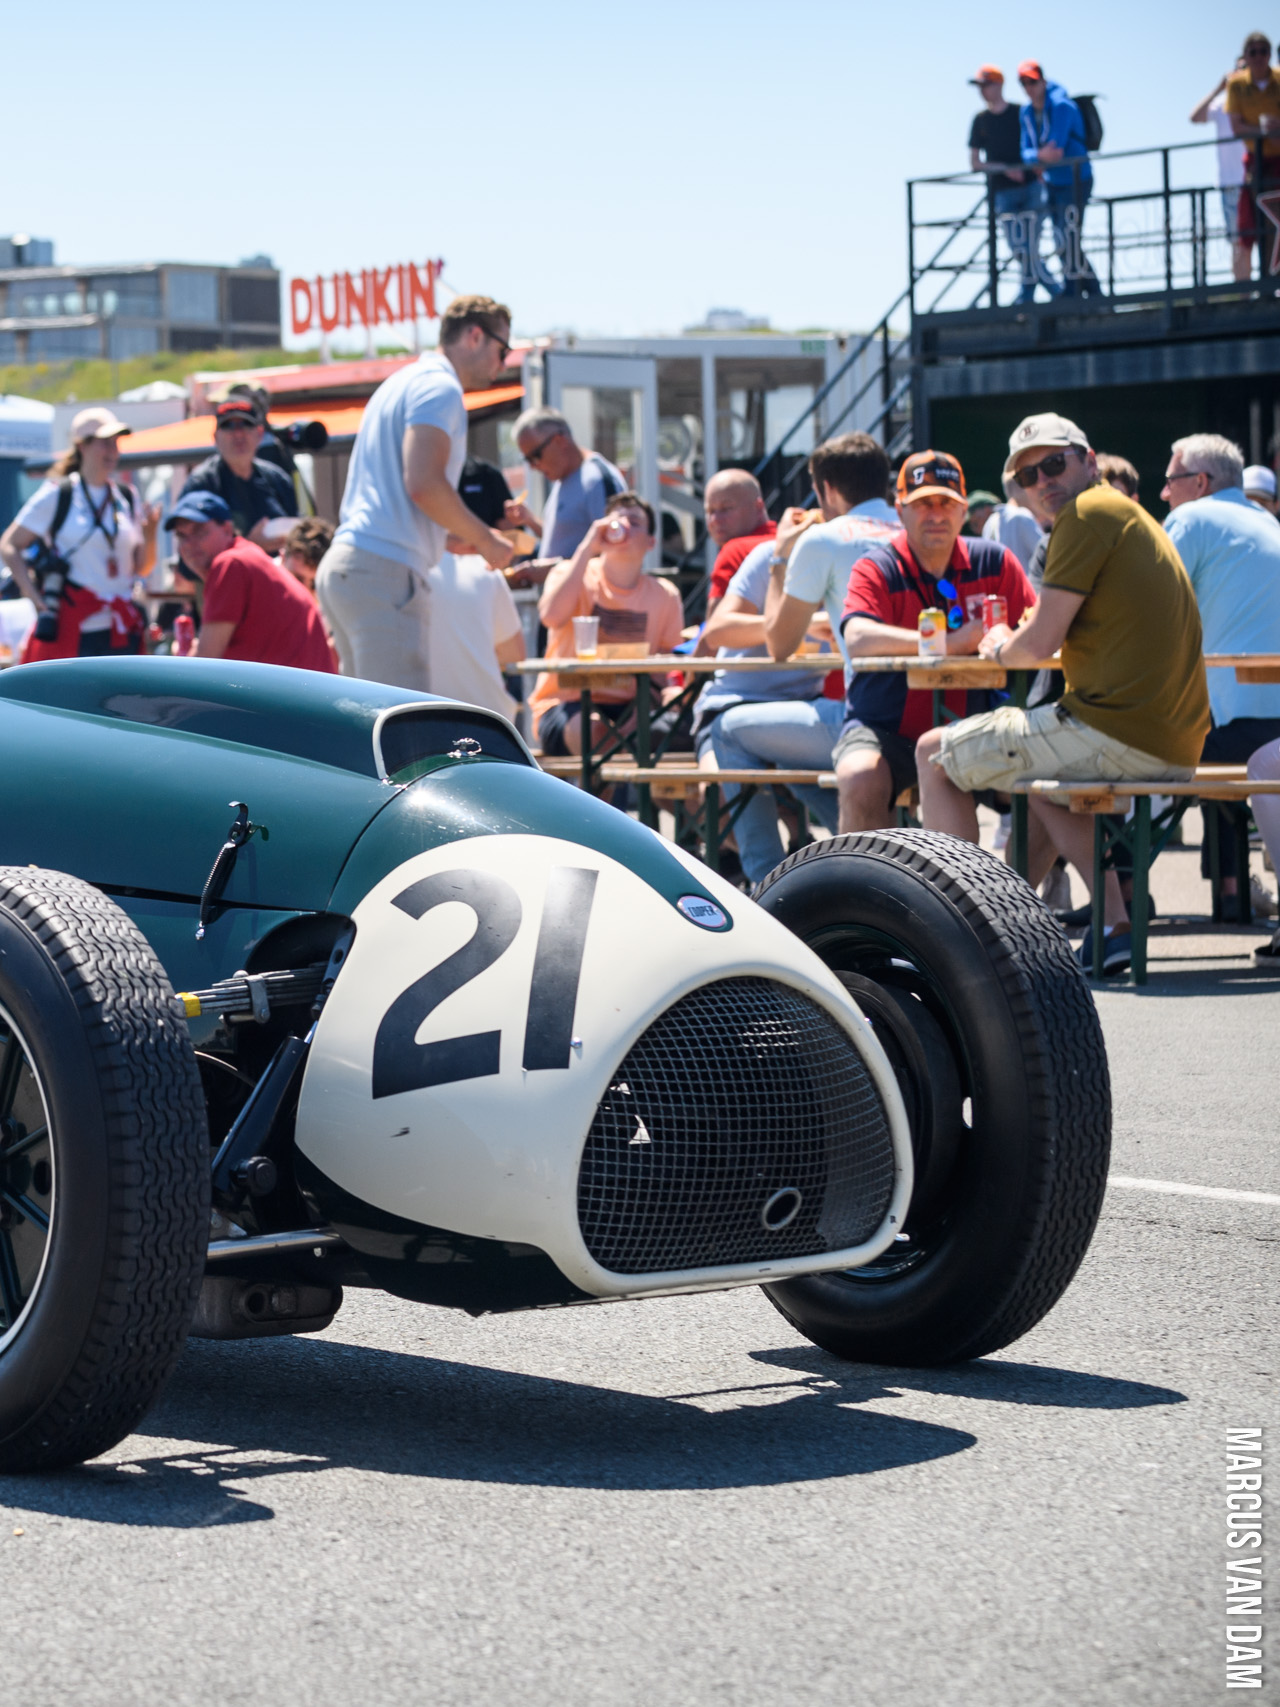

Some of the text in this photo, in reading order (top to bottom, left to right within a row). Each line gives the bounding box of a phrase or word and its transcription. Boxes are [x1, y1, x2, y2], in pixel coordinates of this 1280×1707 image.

[291, 258, 444, 335] DUNKIN'
[687, 905, 718, 918] COOPER
[372, 866, 600, 1101] 21
